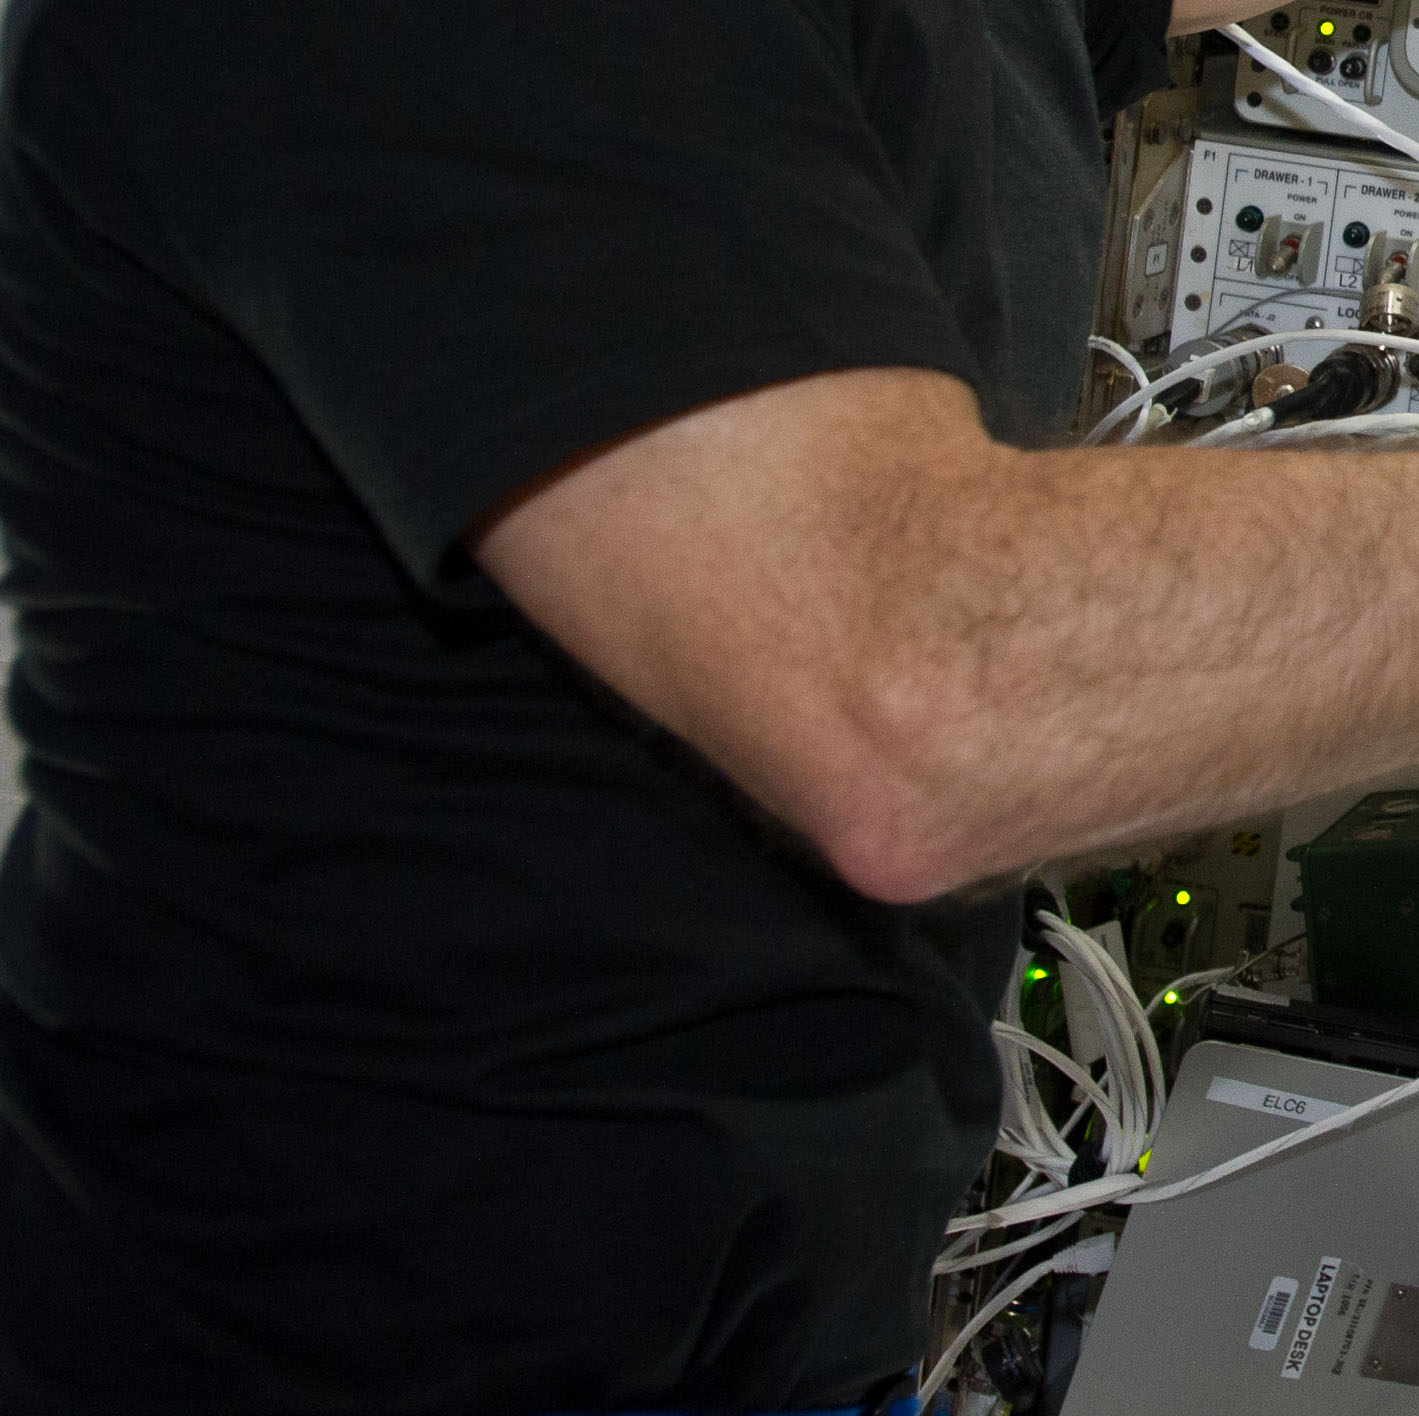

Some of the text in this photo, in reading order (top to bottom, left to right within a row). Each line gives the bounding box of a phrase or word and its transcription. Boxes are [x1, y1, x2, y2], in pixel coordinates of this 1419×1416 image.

[1253, 168, 1299, 186] DRAWER
[1286, 192, 1318, 205] POWER
[1360, 184, 1406, 201] DRAWER
[1293, 213, 1307, 222] ON
[1338, 274, 1358, 289] L2
[1261, 1092, 1308, 1119] ELC6
[1285, 1263, 1337, 1373] LAPTOP DESK
